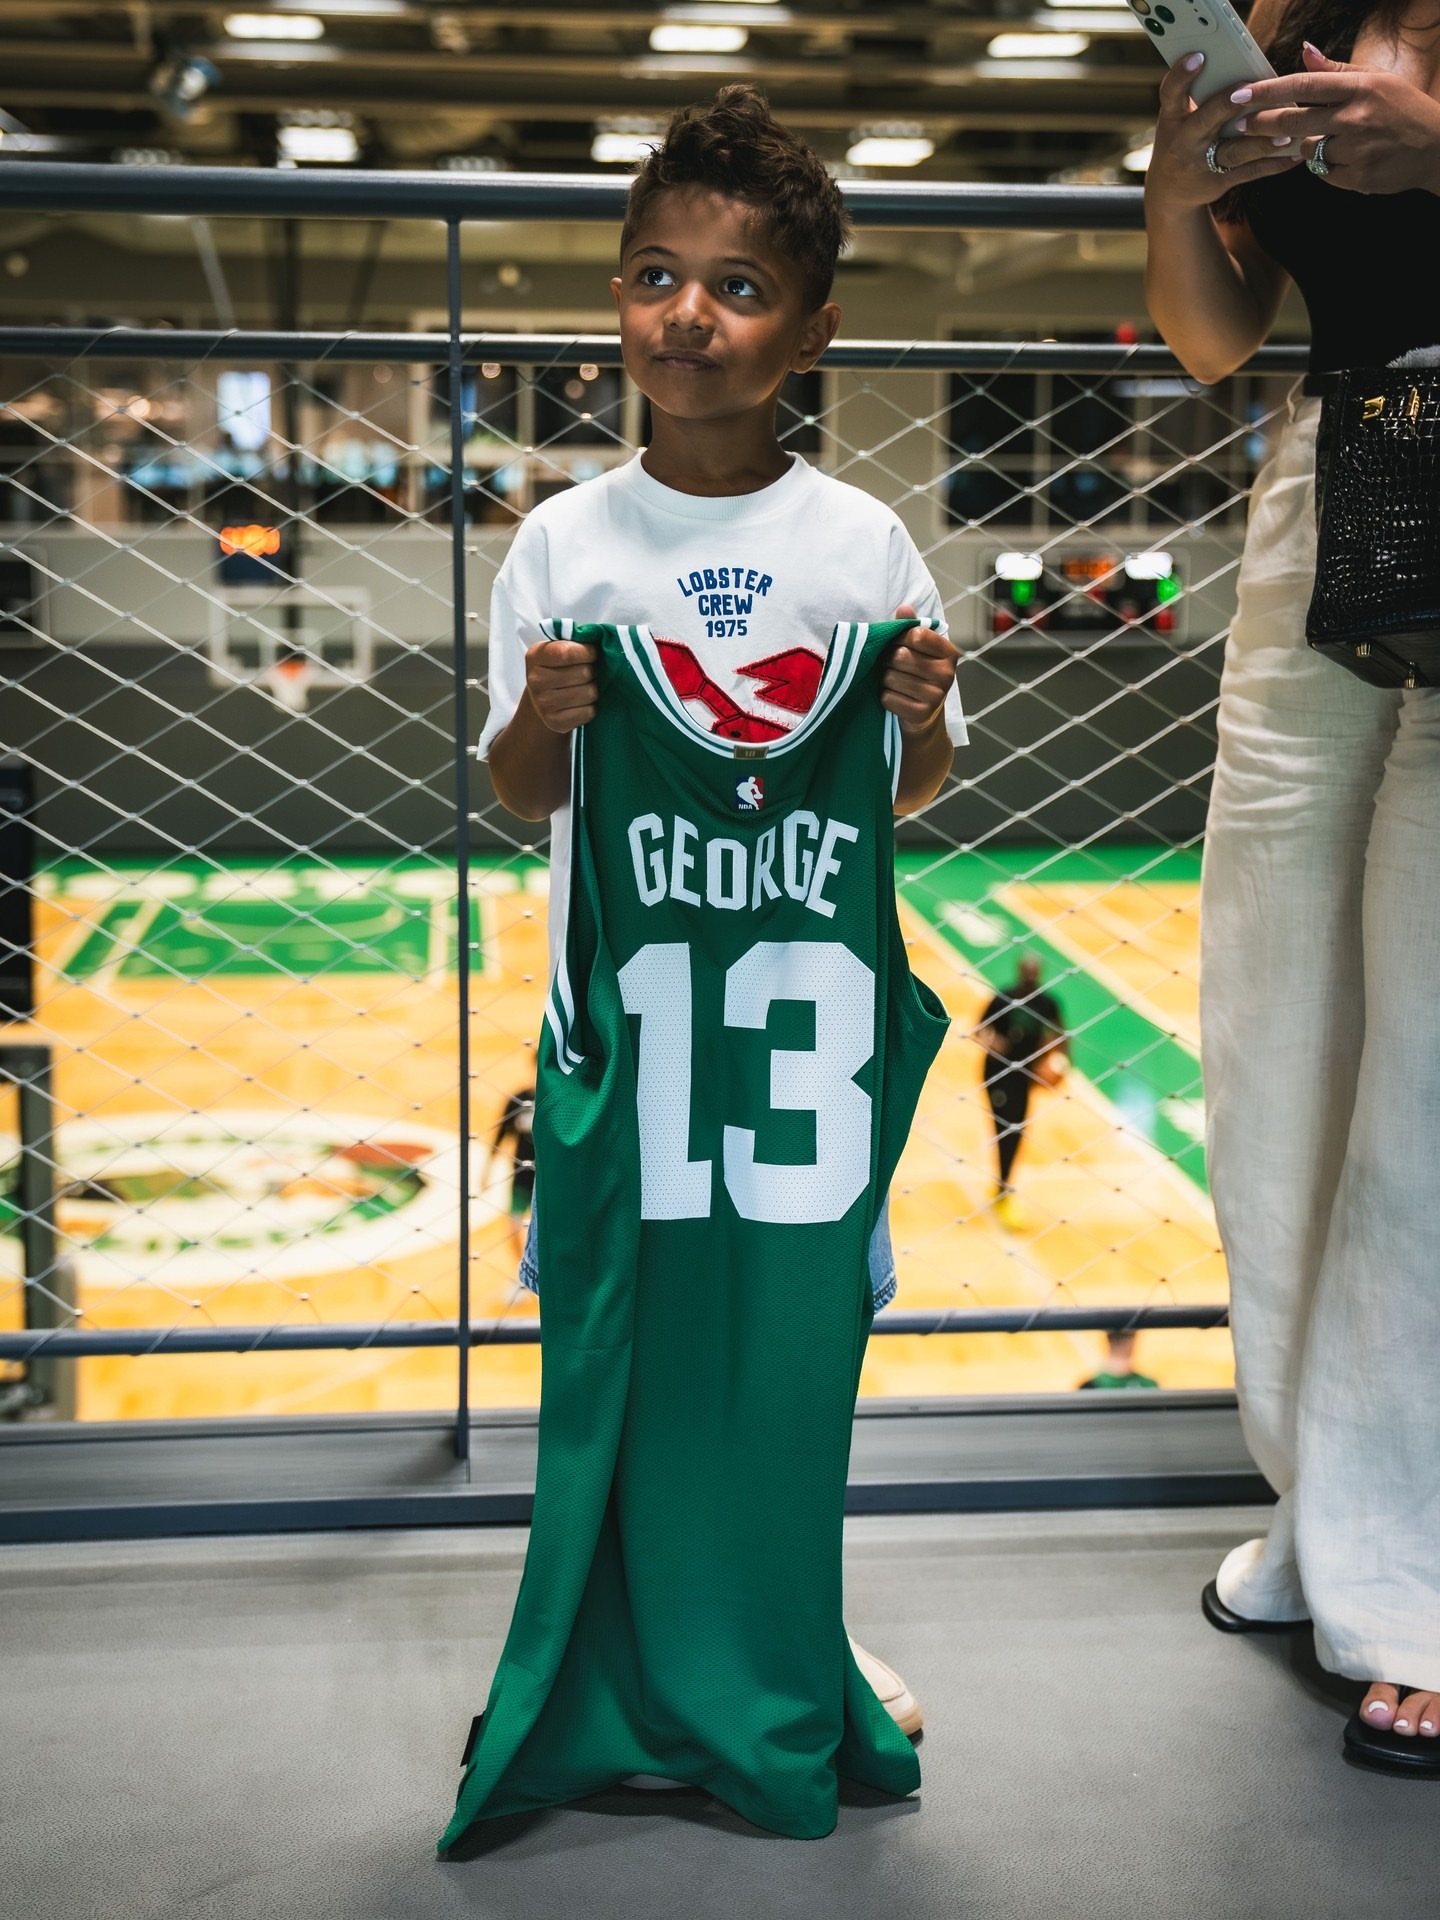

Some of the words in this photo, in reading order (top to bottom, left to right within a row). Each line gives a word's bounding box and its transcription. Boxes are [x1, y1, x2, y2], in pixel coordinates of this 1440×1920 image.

[677, 567, 773, 597] LOBSTER
[698, 593, 753, 616] CREW
[705, 619, 748, 638] 1975
[627, 809, 860, 919] GEORGE
[616, 941, 876, 1224] 13
